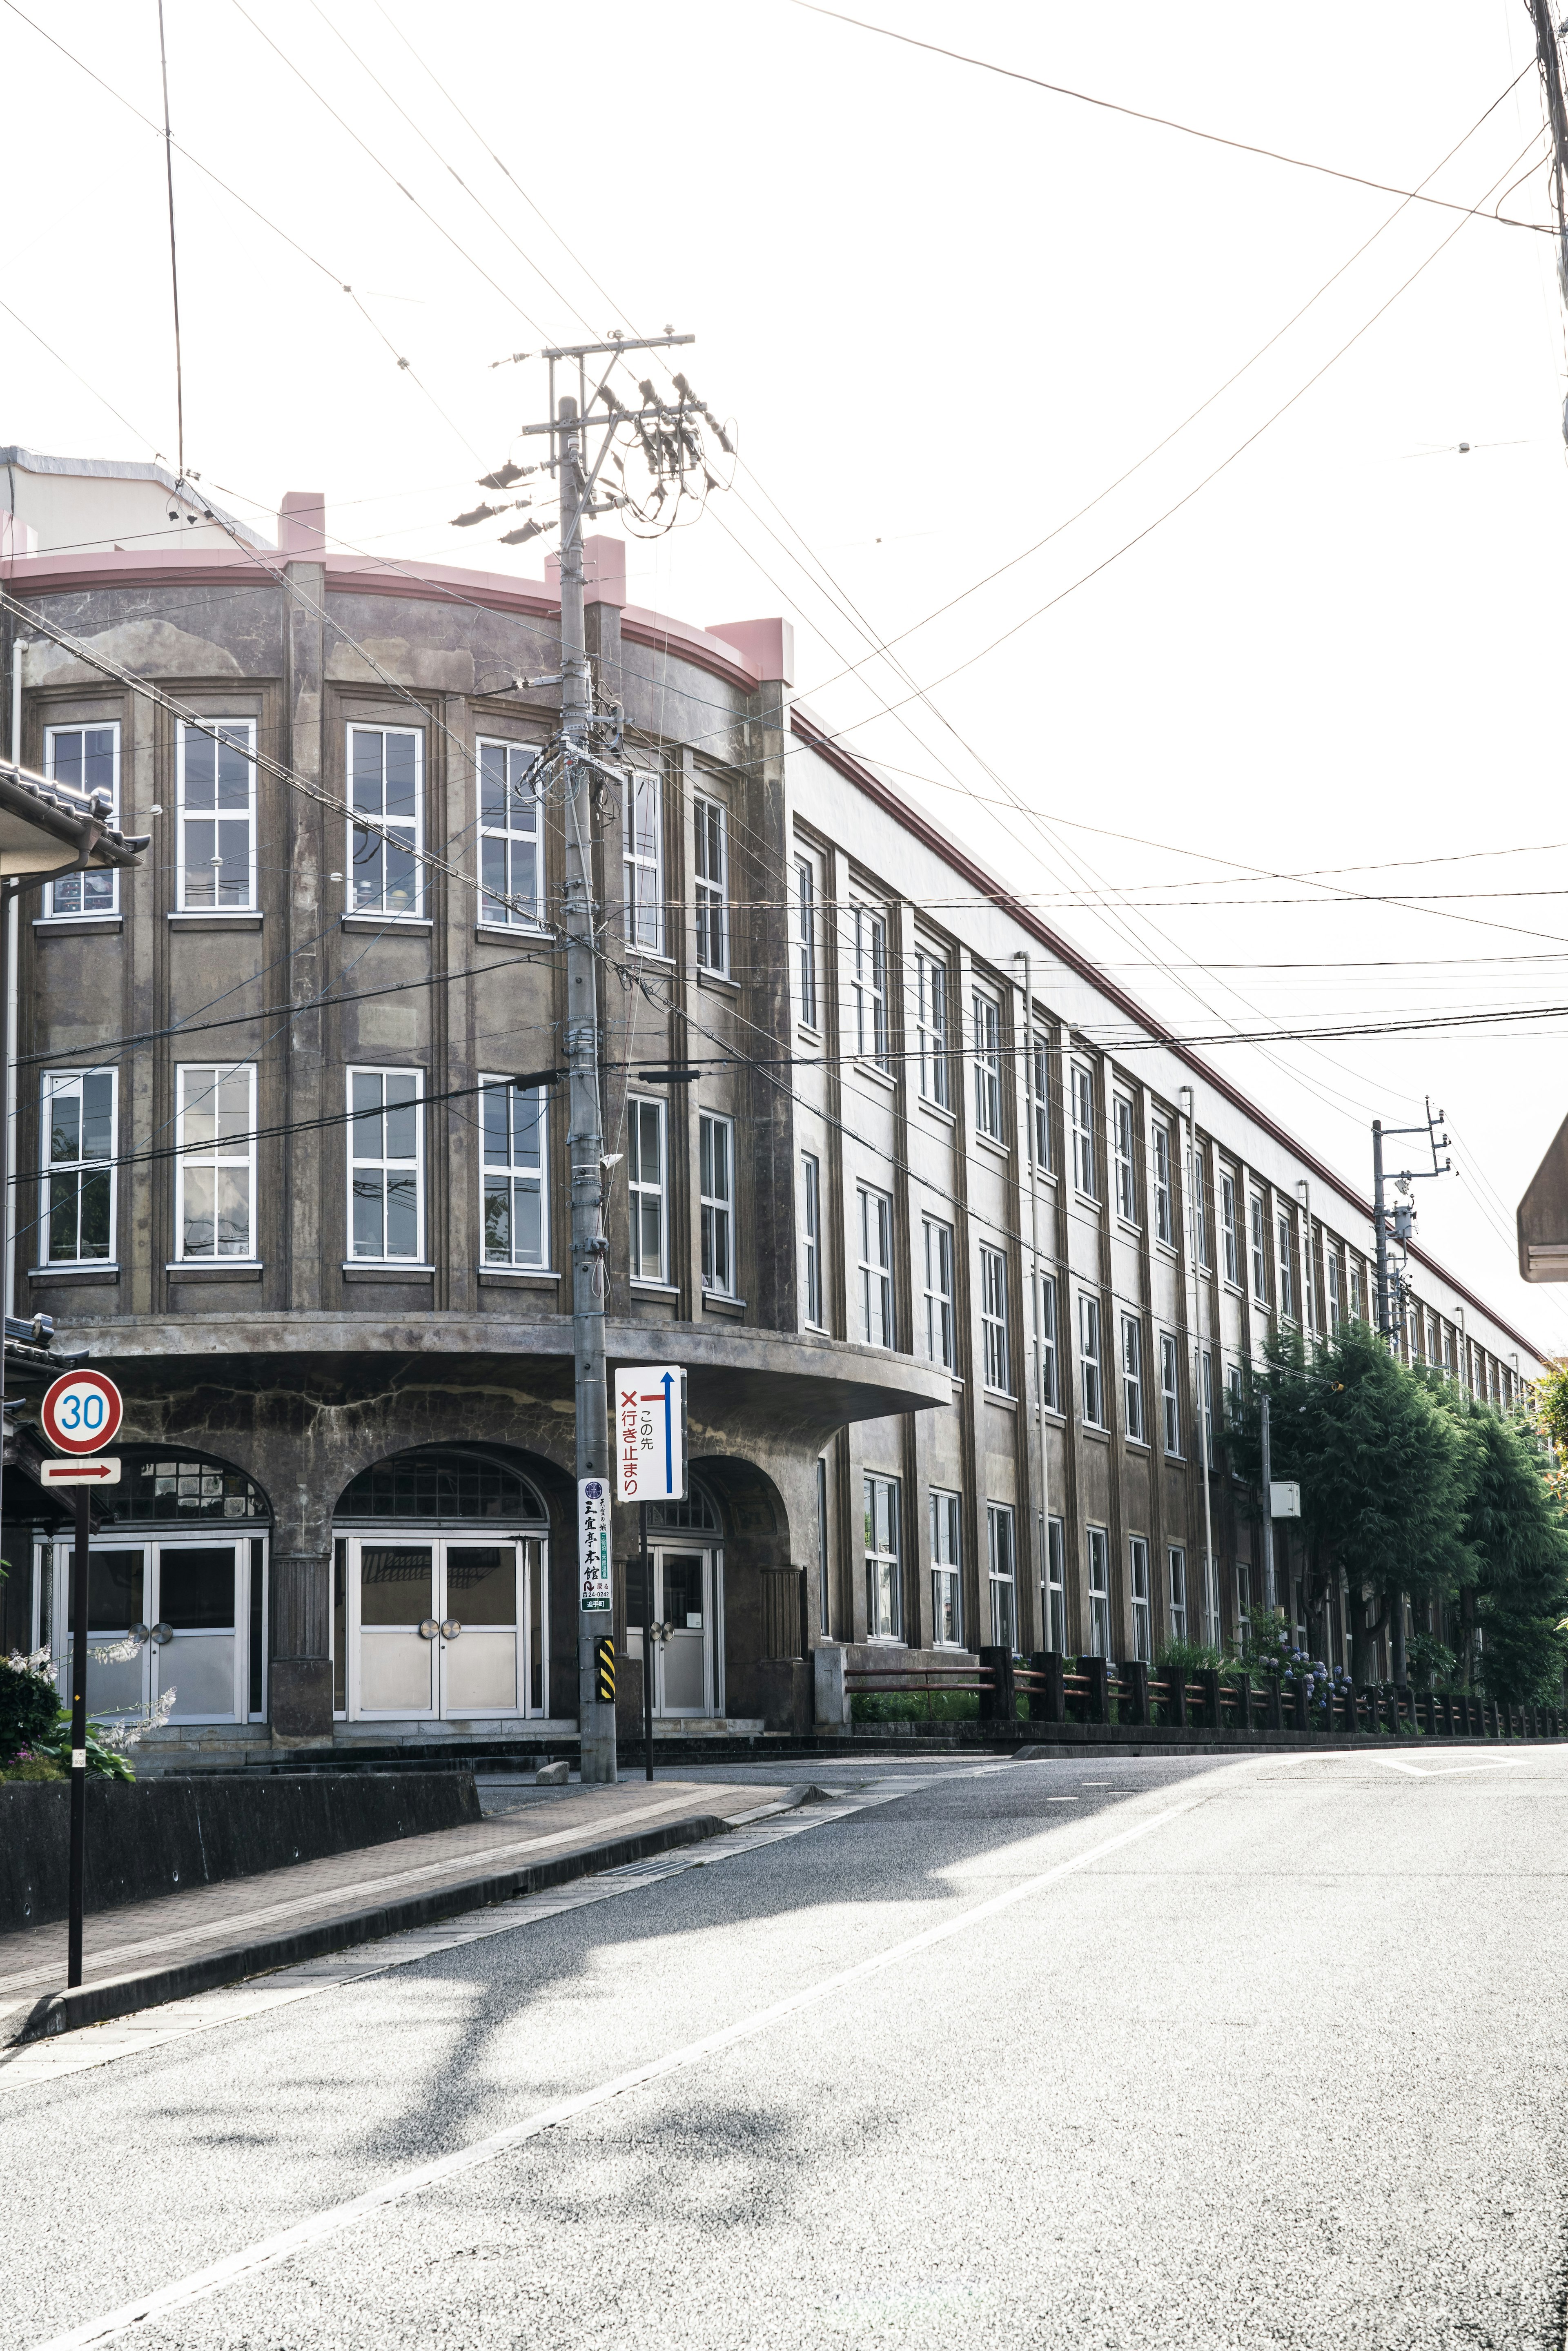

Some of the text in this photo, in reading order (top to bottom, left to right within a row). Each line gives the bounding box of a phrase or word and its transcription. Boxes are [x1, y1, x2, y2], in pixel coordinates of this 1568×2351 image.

[62, 1395, 103, 1429] 30
[641, 1411, 653, 1450] この先
[621, 1411, 638, 1495] 行き止まり
[584, 1500, 600, 1580] 三宜亭本館
